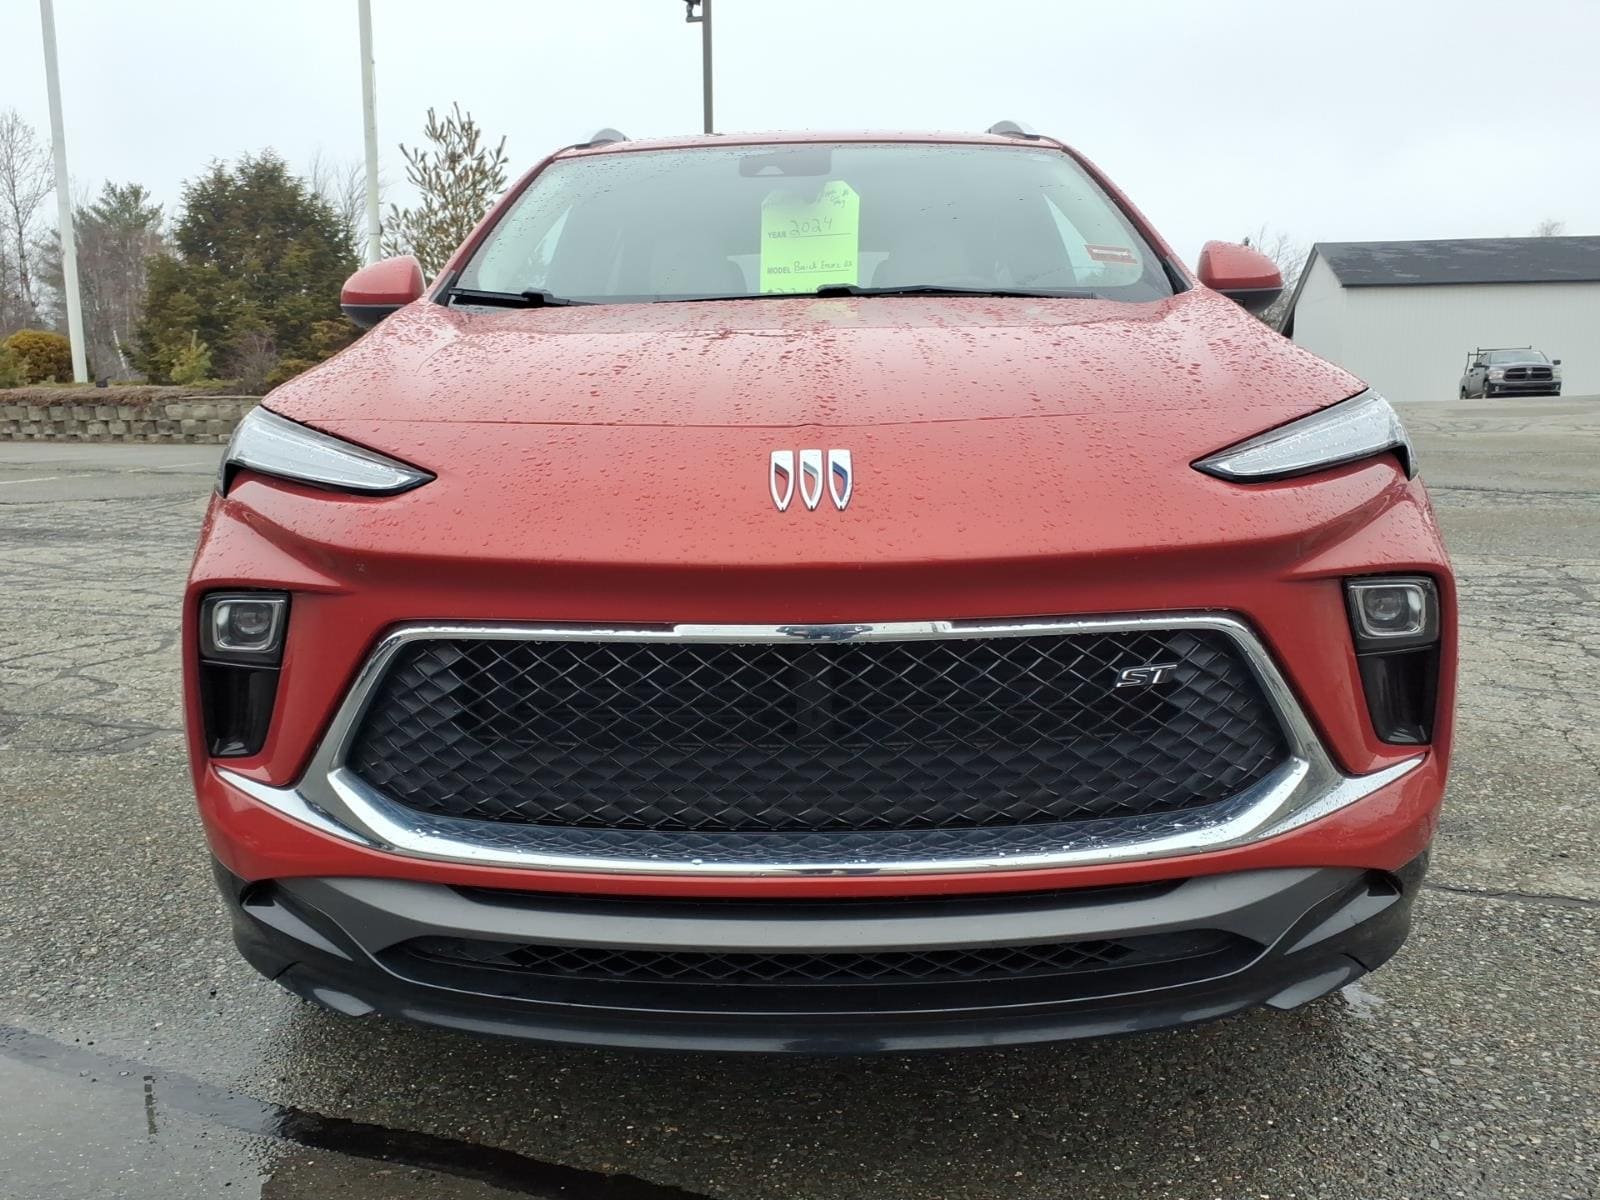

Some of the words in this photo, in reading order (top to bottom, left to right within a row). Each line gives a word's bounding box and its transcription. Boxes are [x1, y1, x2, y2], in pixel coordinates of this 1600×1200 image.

[767, 231, 787, 239] YEAR
[789, 216, 833, 237] 2024
[767, 266, 791, 274] MODEL
[1115, 662, 1178, 688] ST
